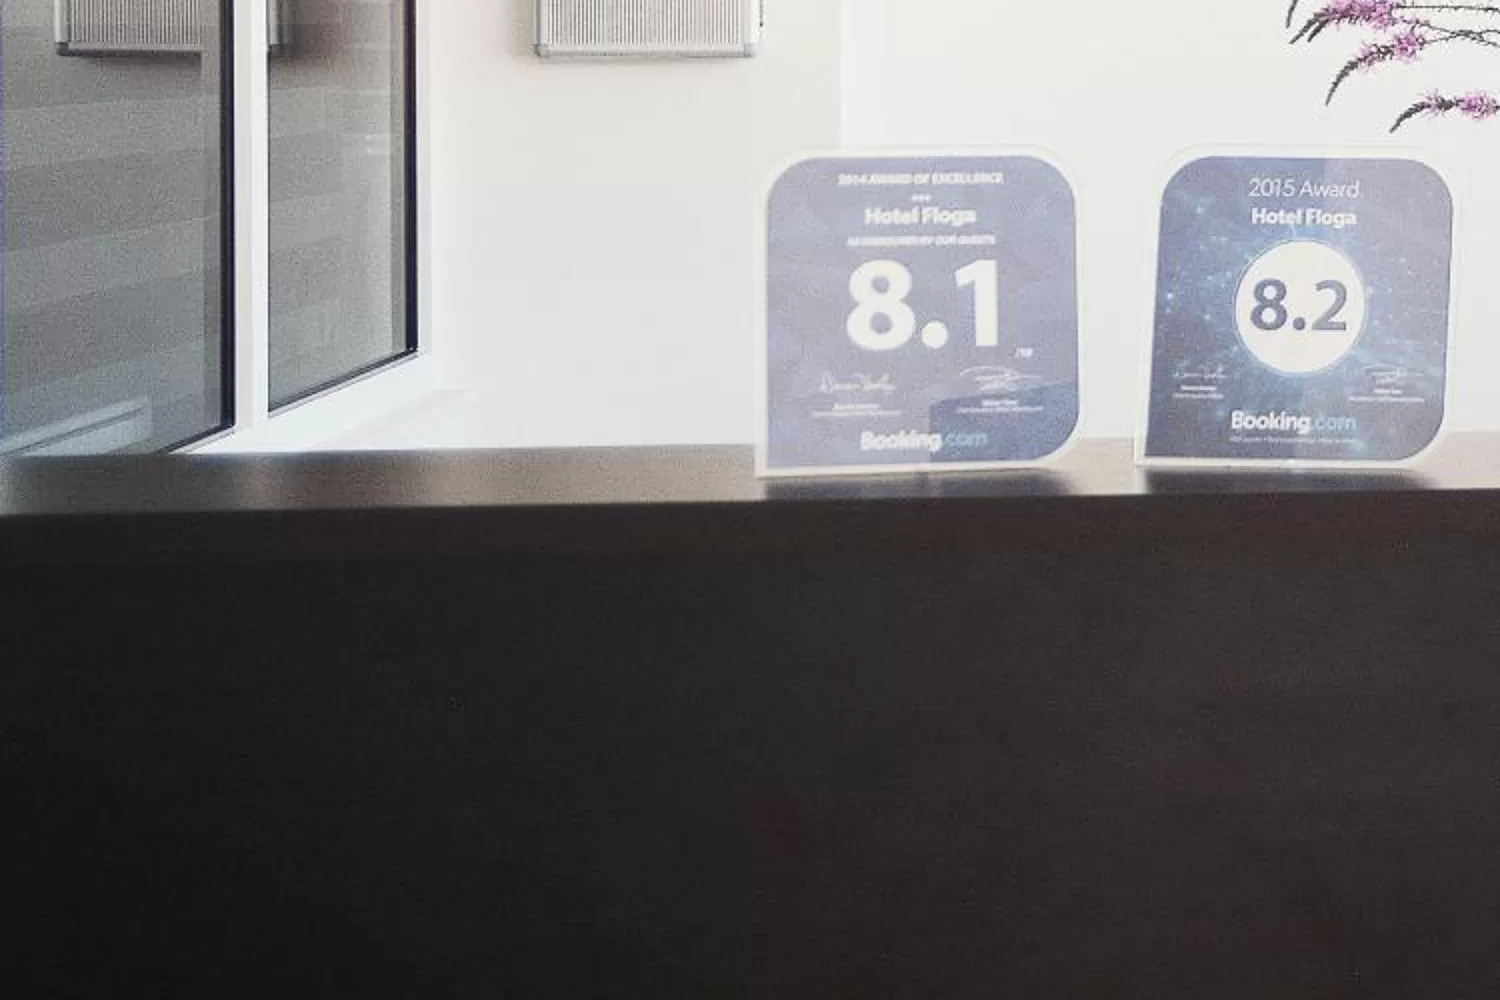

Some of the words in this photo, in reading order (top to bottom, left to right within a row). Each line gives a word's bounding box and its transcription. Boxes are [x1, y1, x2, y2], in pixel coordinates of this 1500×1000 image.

[1248, 177, 1296, 198] 2015
[1299, 179, 1361, 198] Award
[864, 206, 919, 225] Hotel
[922, 206, 977, 227] Floga
[1251, 207, 1302, 225] Hotel
[1305, 208, 1358, 229] Floga
[846, 259, 1000, 351] 8.1
[1250, 278, 1348, 332] 8.2
